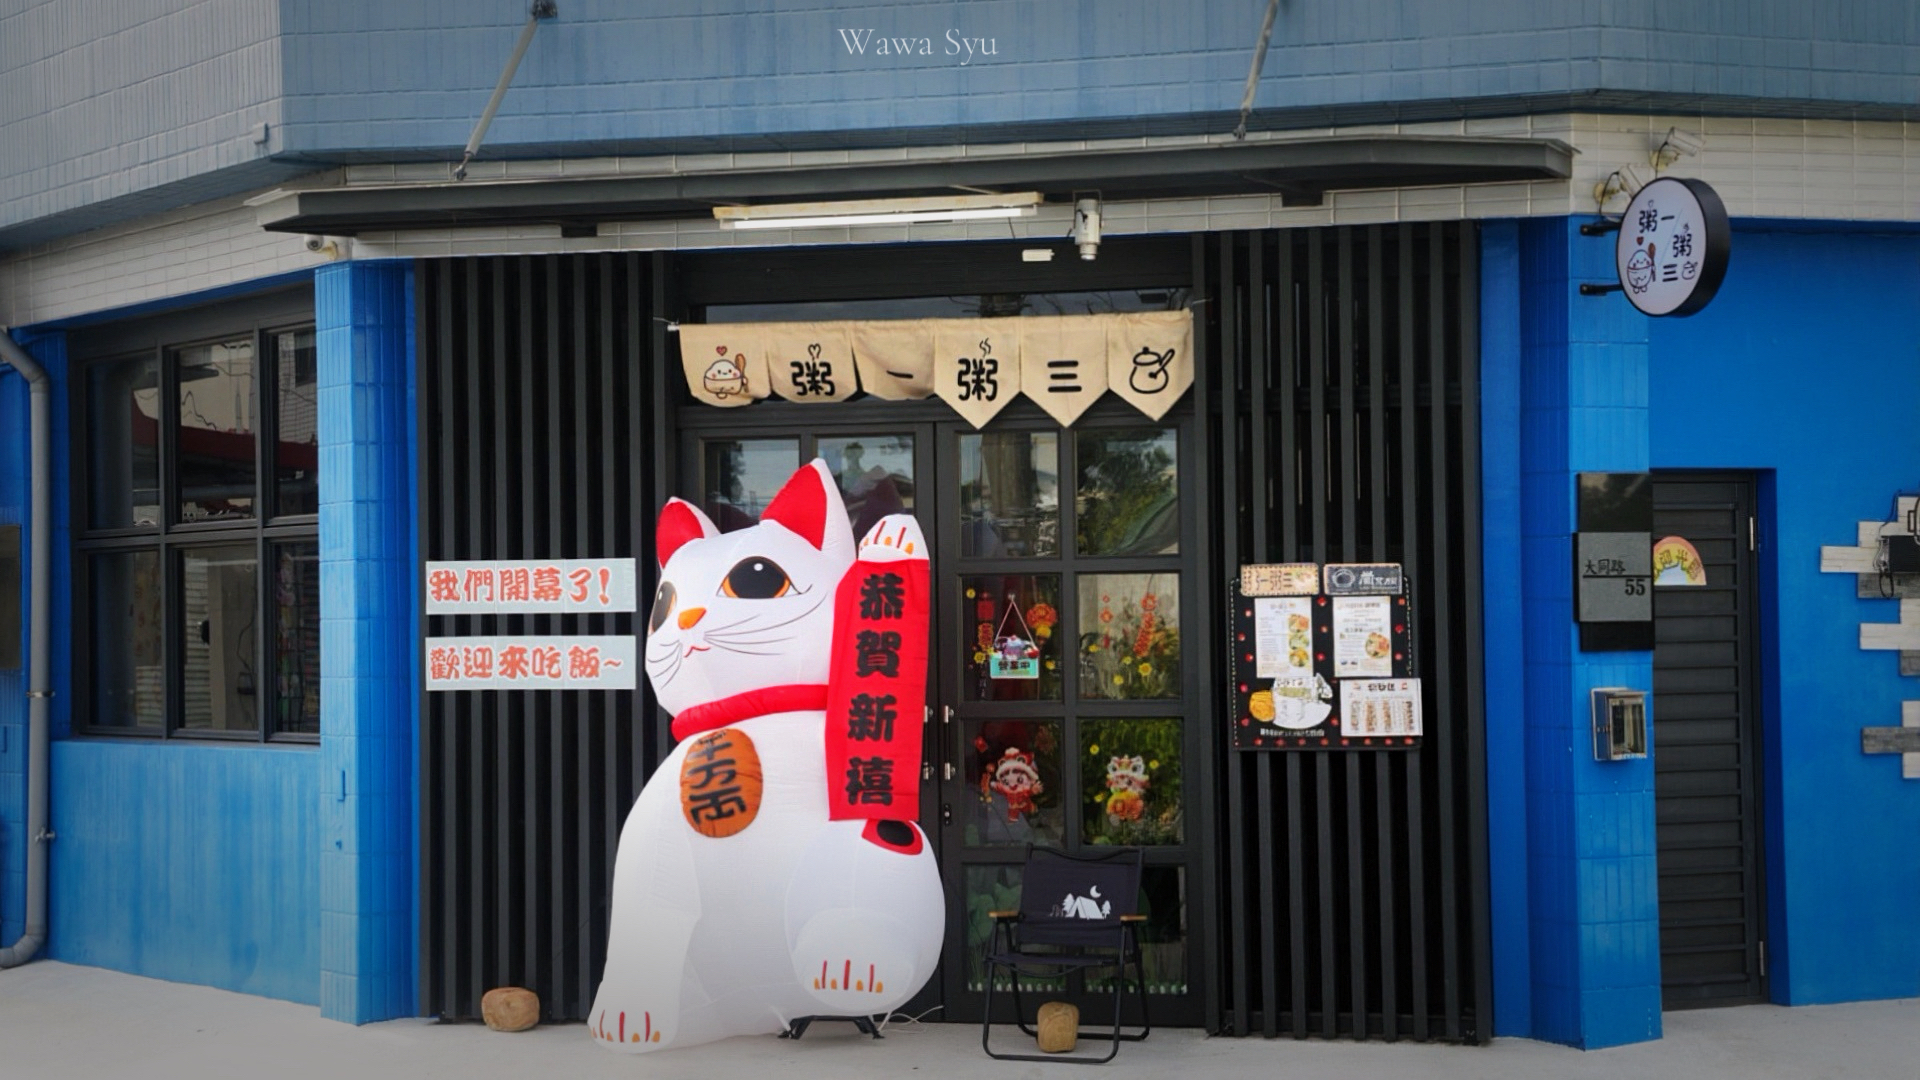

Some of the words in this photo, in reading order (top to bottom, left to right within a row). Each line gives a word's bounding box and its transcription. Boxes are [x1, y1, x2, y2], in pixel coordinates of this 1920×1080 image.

[1584, 558, 1626, 575] 大同路
[428, 566, 611, 605] 我們開幕了!
[1624, 578, 1646, 596] 55
[428, 645, 623, 681] 歡迎來吃飯~
[845, 572, 905, 806] 恭賀新禧
